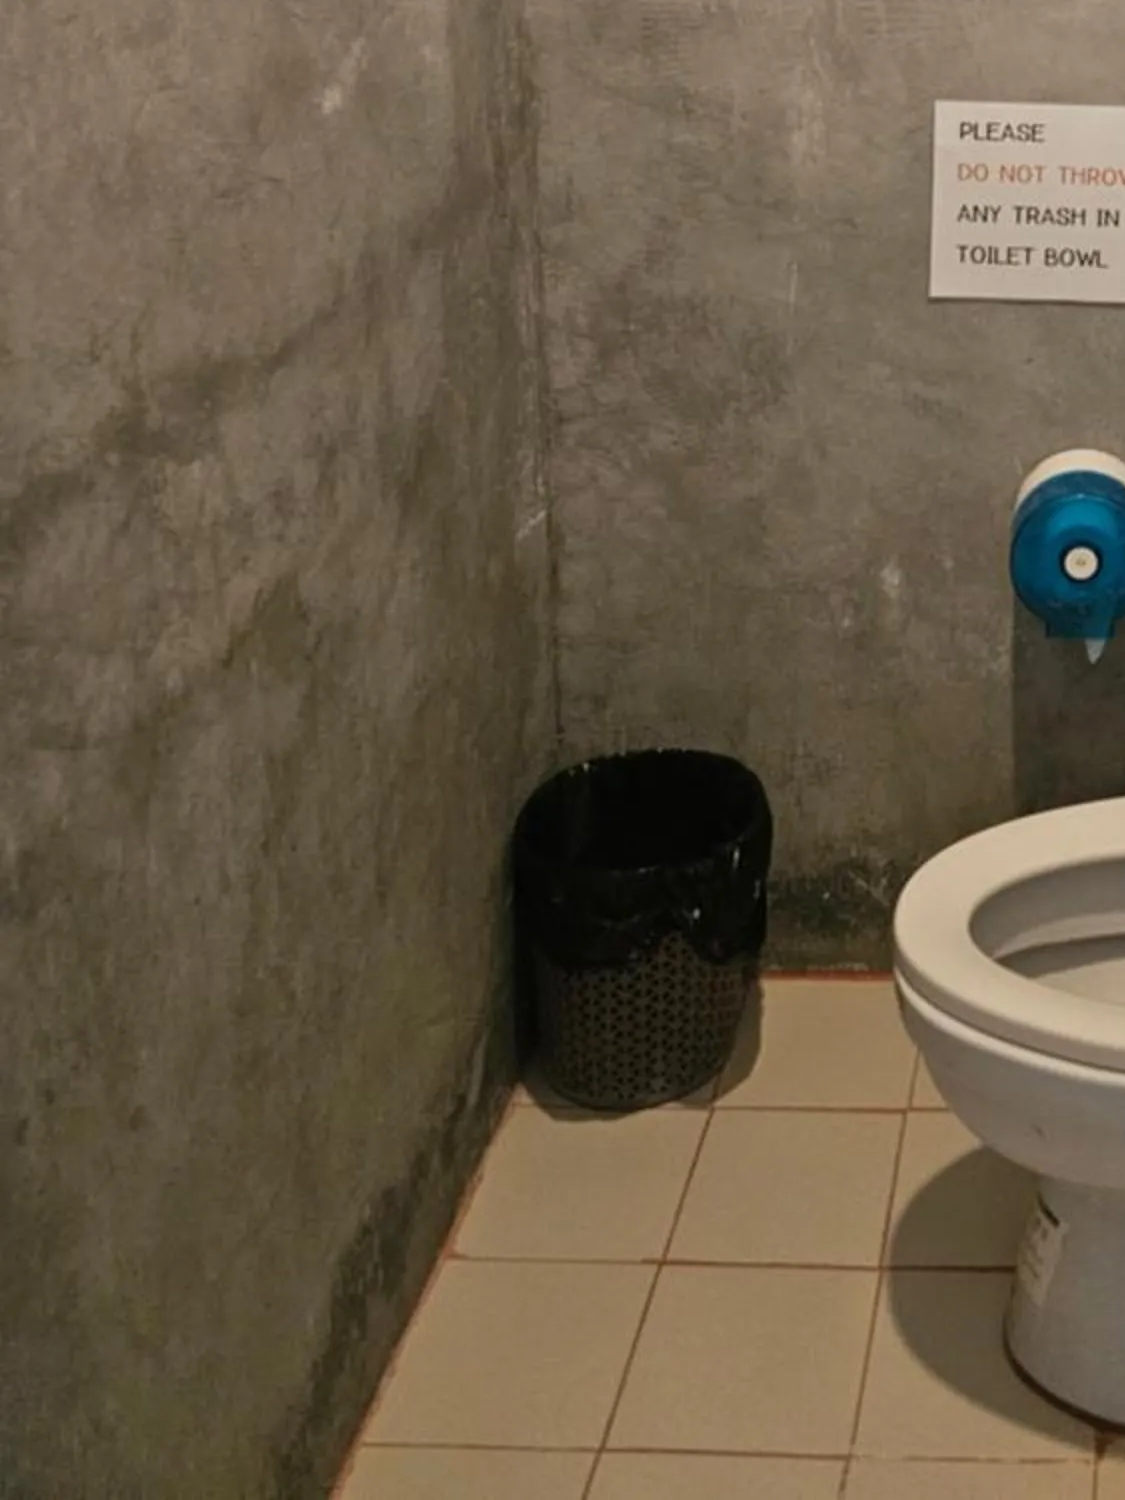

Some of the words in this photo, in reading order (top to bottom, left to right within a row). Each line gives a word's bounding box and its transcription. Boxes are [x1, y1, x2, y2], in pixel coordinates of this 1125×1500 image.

[960, 121, 1044, 143] PLEASE
[957, 163, 989, 182] DO
[999, 165, 1047, 184] NOT
[957, 204, 1001, 223] ANY
[1014, 206, 1086, 226] TRASH
[1097, 209, 1120, 227] IN
[956, 245, 1034, 266] TOILET
[1044, 248, 1108, 269] BOWL
